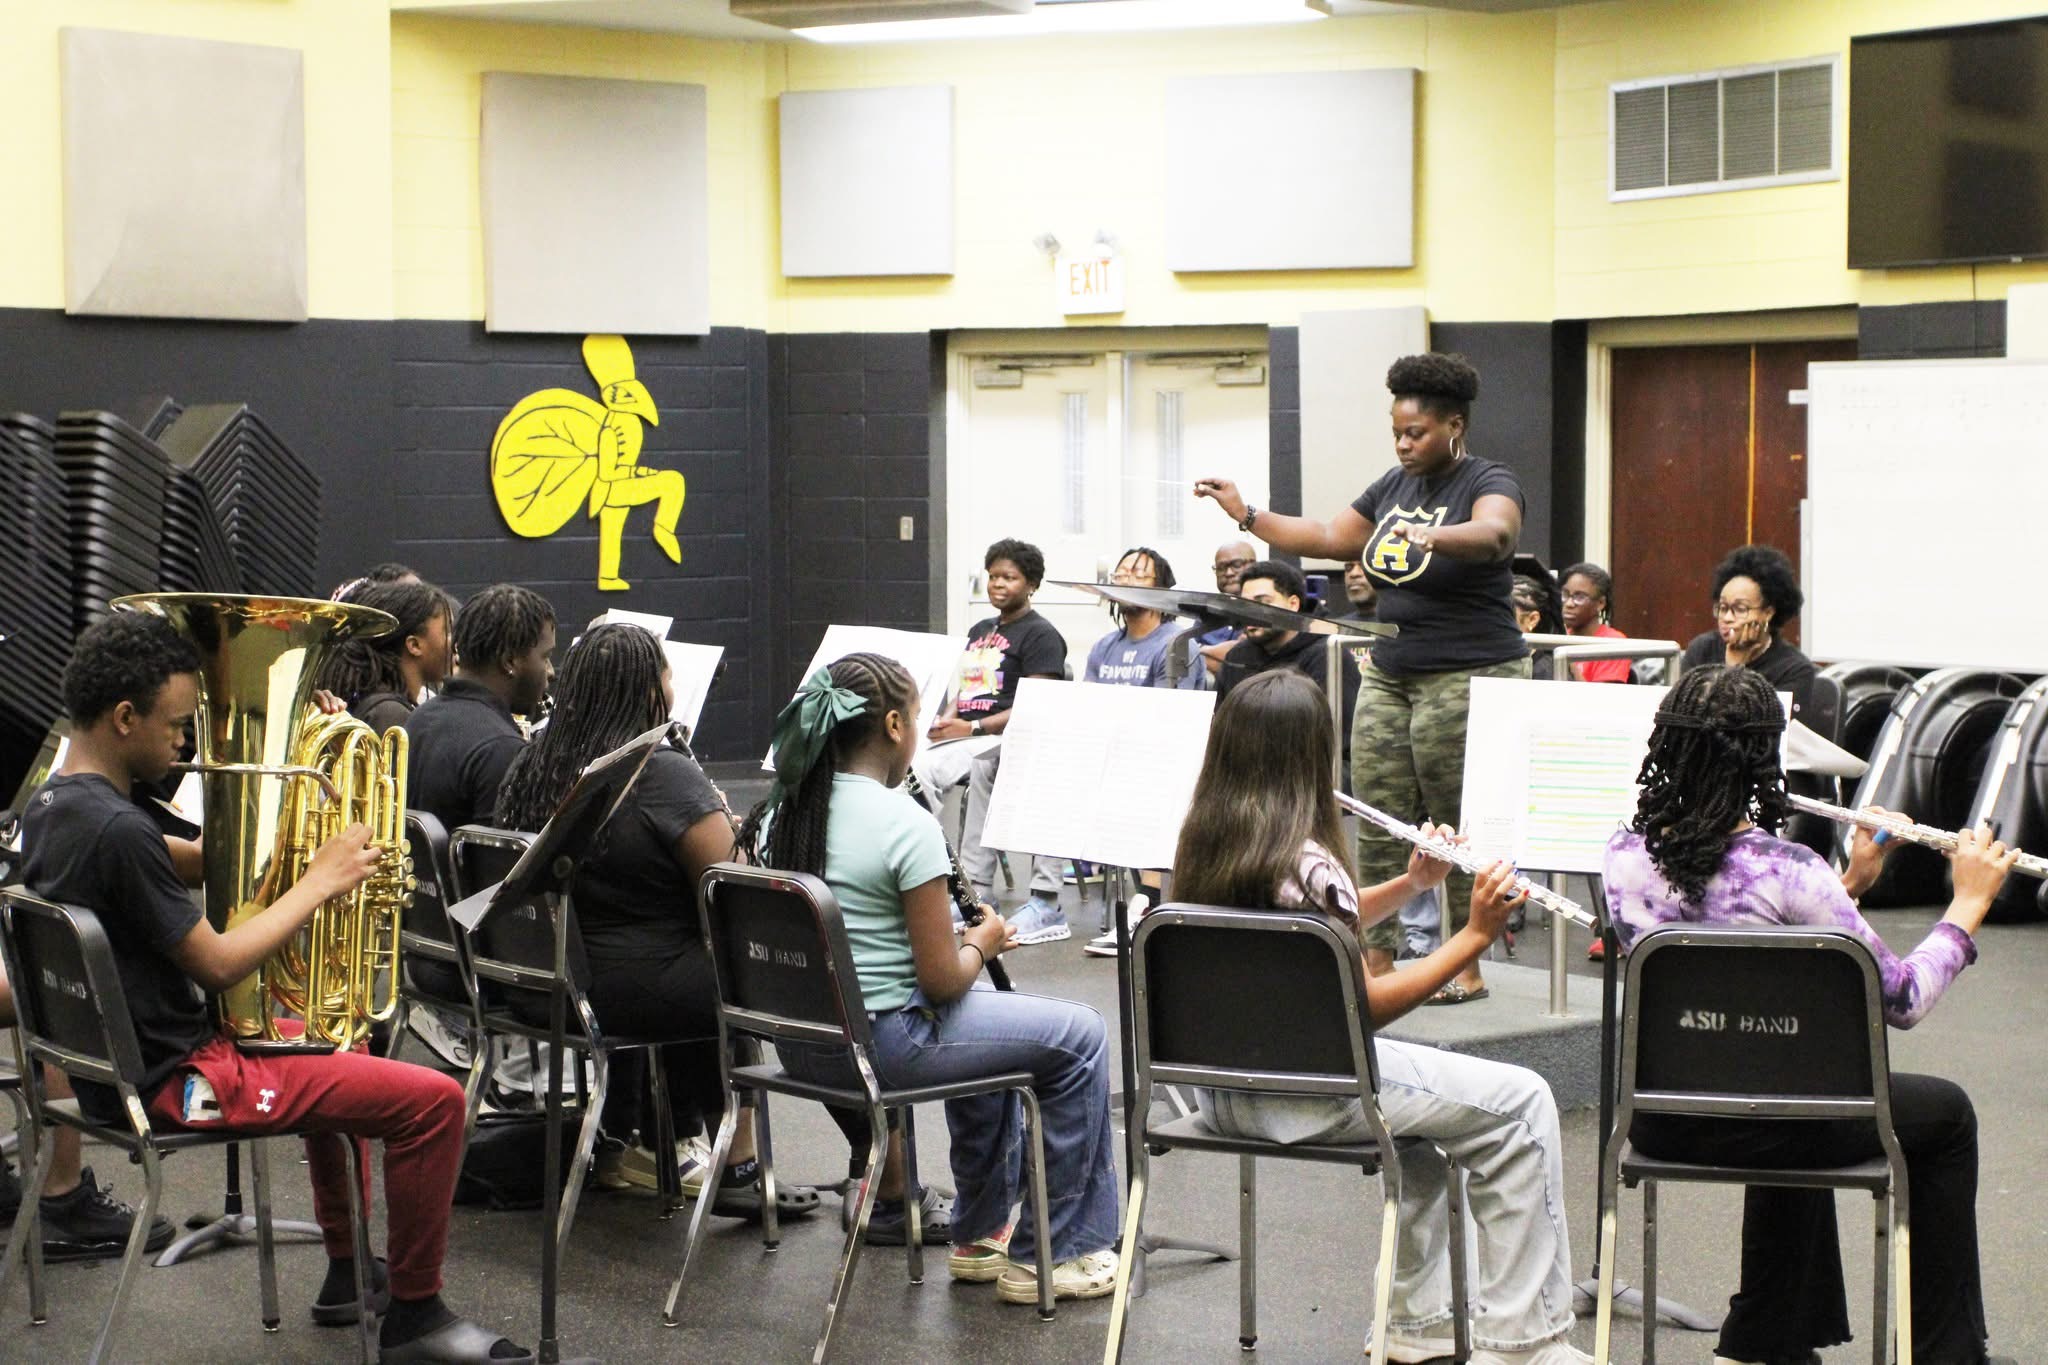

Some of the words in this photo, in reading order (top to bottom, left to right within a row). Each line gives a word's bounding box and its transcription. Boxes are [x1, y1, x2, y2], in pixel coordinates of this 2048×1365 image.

[1069, 258, 1110, 296] EXIT
[1098, 664, 1150, 680] FAVORITE
[747, 941, 769, 962] ASU
[775, 948, 807, 968] BAND
[1679, 1009, 1726, 1031] ASU
[1740, 1015, 1799, 1034] BAND
